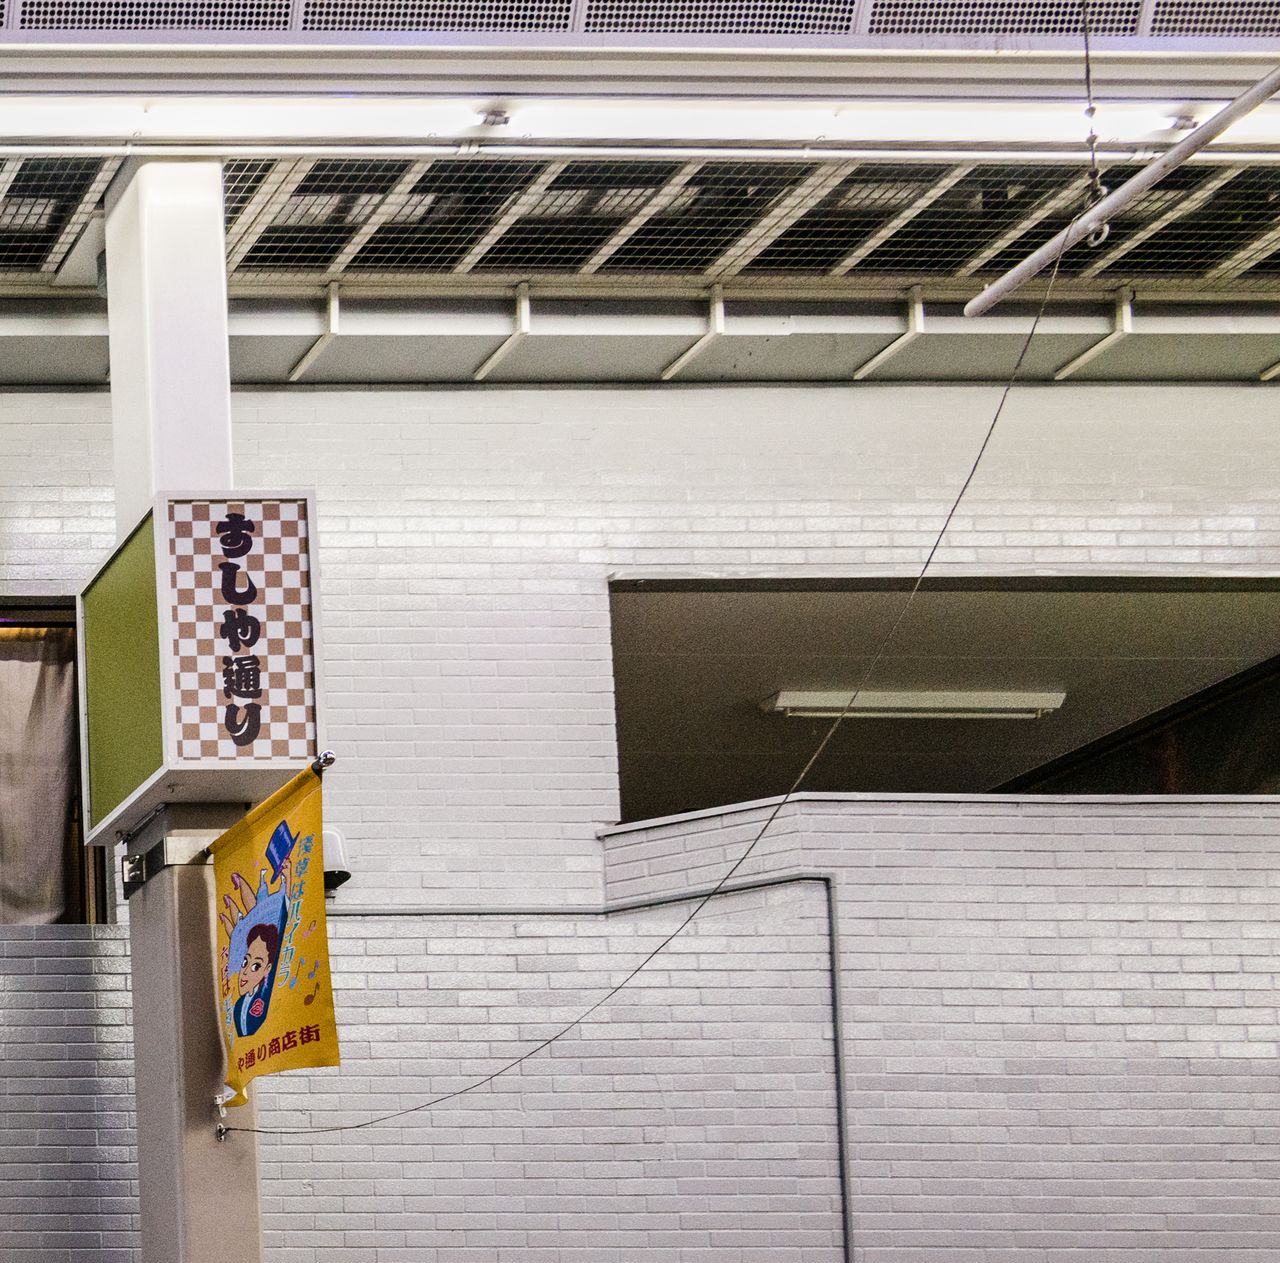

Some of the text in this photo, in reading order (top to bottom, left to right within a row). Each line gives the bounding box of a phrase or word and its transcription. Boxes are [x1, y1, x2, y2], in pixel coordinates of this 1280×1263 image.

[215, 512, 263, 747] すしや通り
